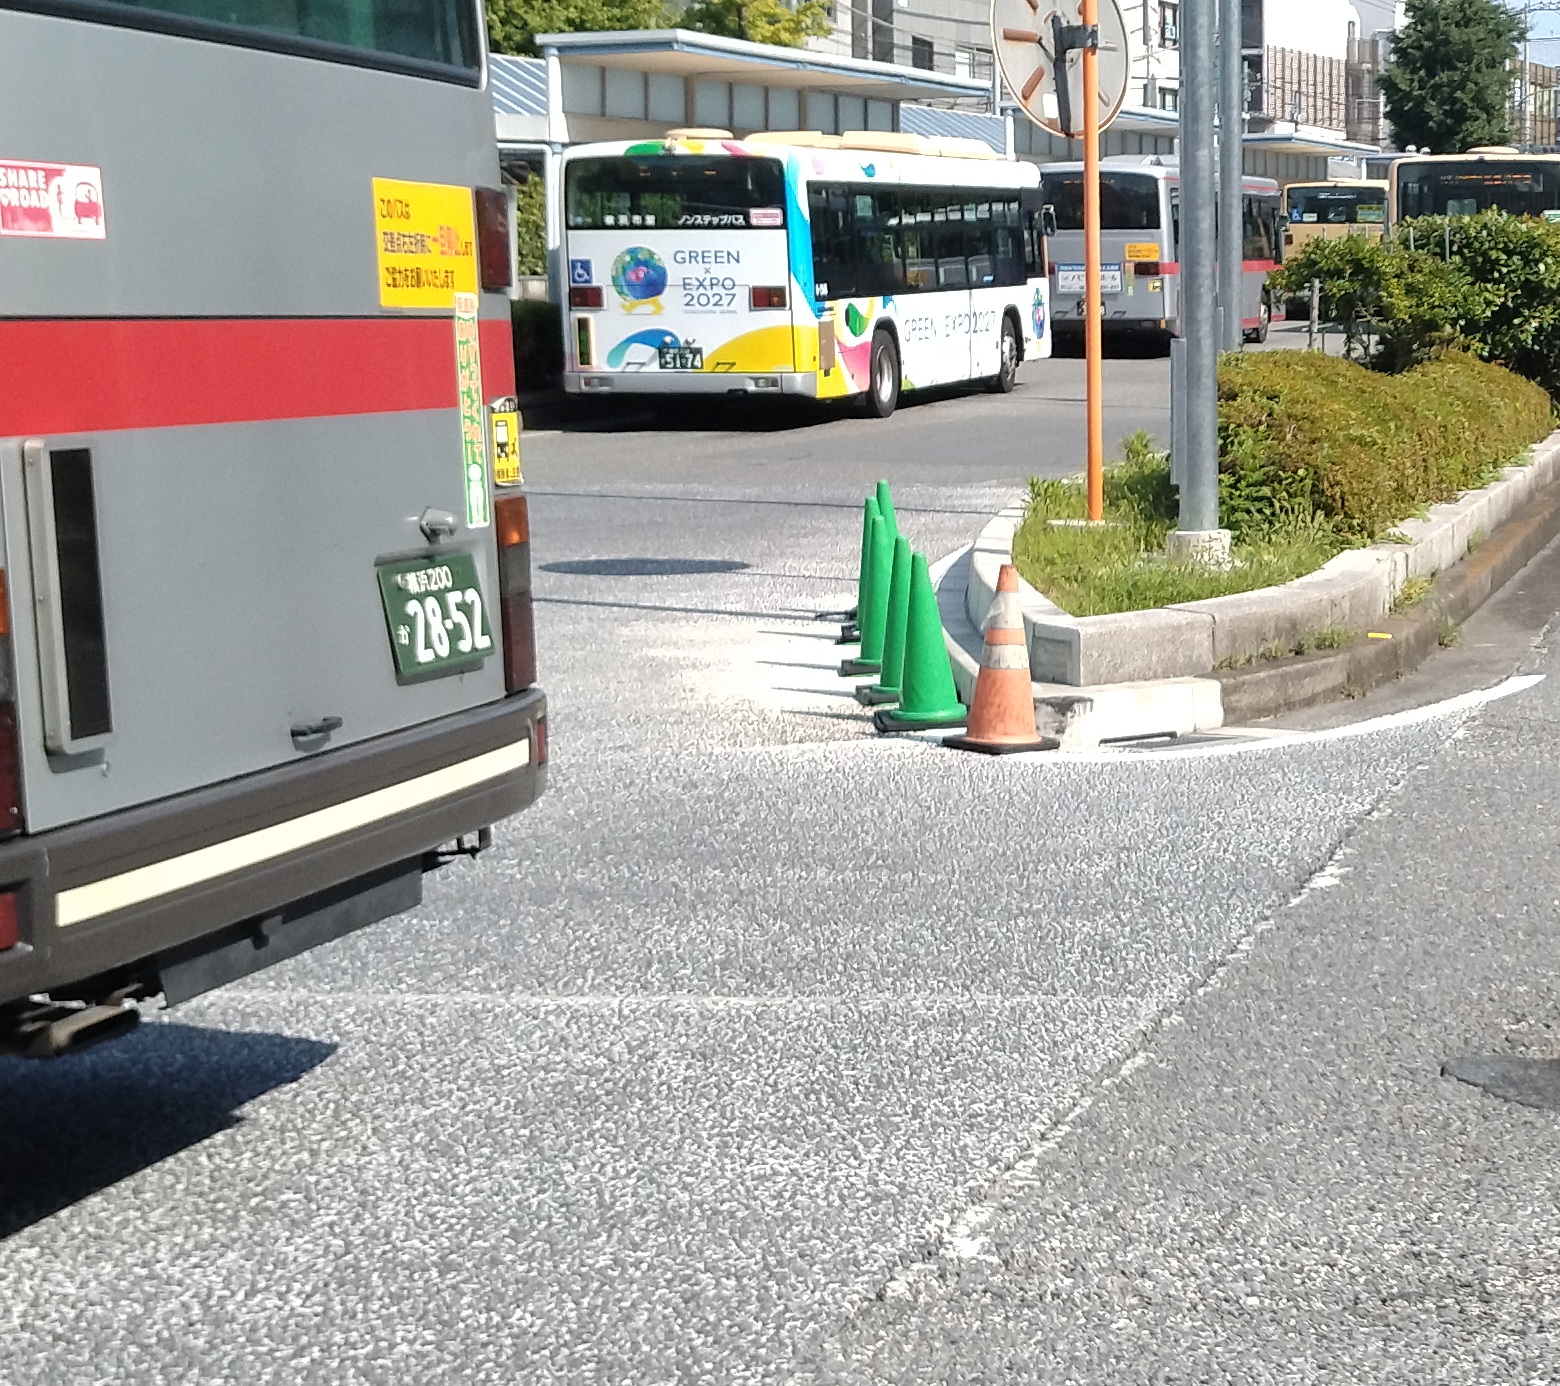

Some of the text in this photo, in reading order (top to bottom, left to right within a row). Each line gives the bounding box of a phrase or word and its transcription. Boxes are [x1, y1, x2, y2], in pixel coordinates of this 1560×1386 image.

[0, 167, 48, 190] SHARE
[10, 187, 50, 209] ROAD
[677, 214, 746, 226] ノンステップバス
[673, 250, 741, 265] GREEN
[682, 276, 737, 292] EXPO
[683, 292, 737, 308] 2027
[904, 310, 996, 342] GREEN EXPO 2027
[406, 565, 453, 595] 横浜200
[405, 587, 492, 664] 28-52
